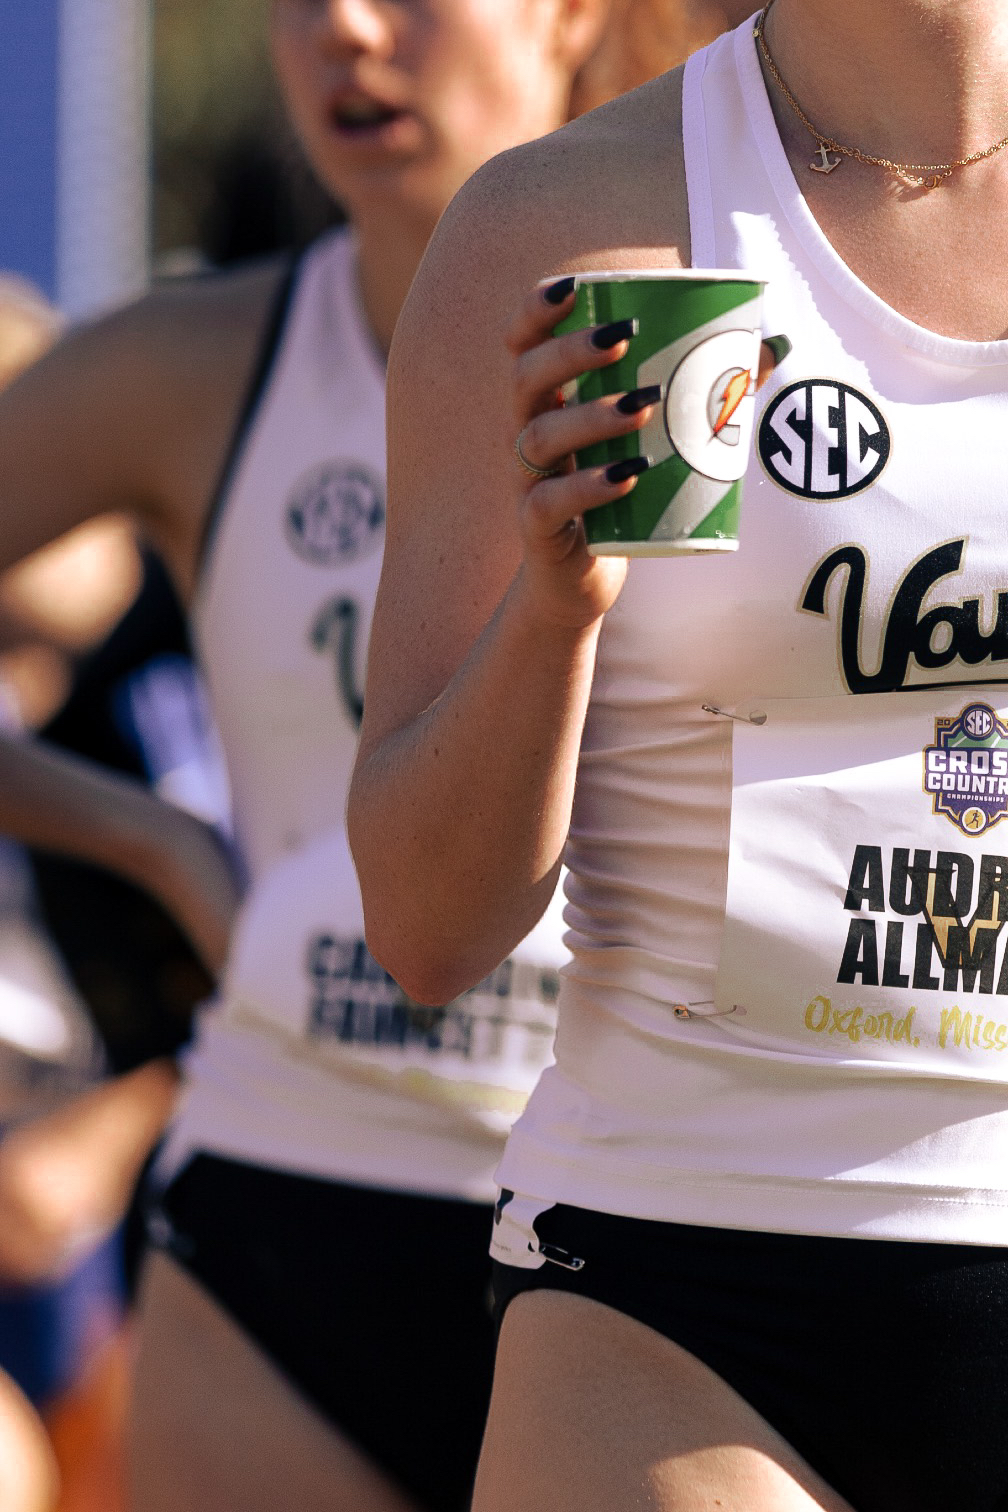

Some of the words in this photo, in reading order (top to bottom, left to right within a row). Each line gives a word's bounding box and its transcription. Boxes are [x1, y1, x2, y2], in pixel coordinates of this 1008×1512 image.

[768, 384, 882, 493] SEC
[966, 710, 992, 735] SEC
[946, 793, 1005, 803] CHAMPIONSHIPS
